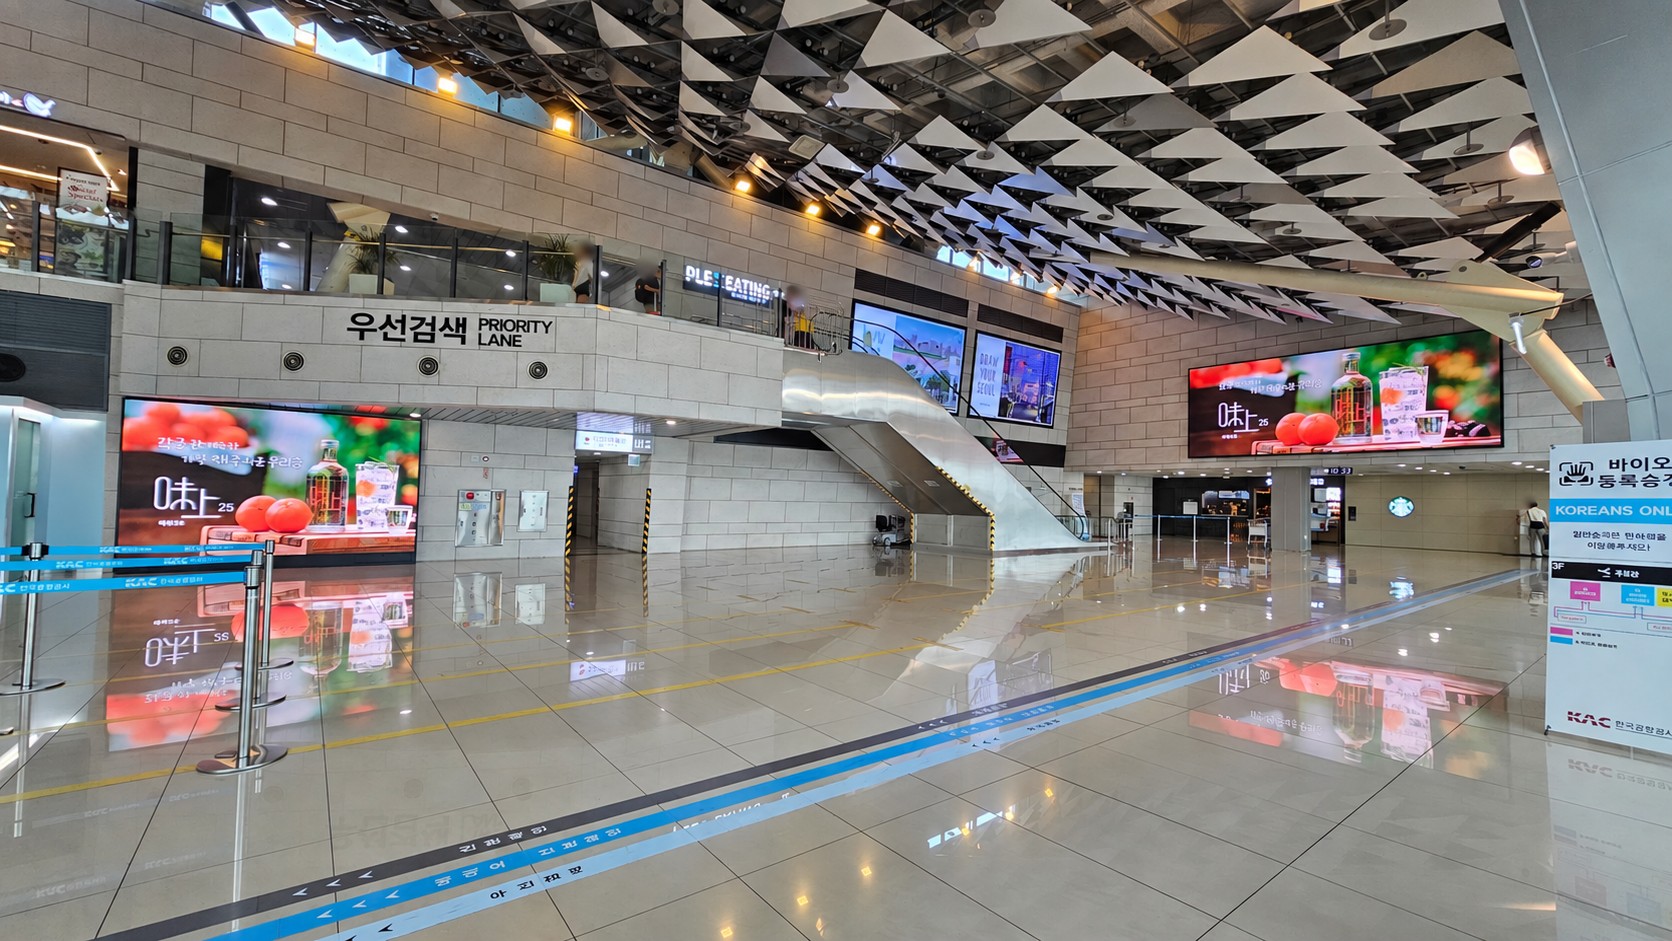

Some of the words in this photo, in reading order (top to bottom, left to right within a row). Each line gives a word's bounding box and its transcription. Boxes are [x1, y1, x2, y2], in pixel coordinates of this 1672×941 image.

[346, 312, 467, 345] 우선검색
[479, 317, 553, 335] PRIORITY
[478, 333, 522, 347] LANE
[1609, 456, 1672, 472] 바이오
[217, 502, 235, 513] 25
[1555, 505, 1633, 516] KOREANS
[1639, 505, 1672, 517] ONL
[56, 560, 84, 569] KAC
[1551, 562, 1565, 570] 3F
[1567, 710, 1612, 729] KAC
